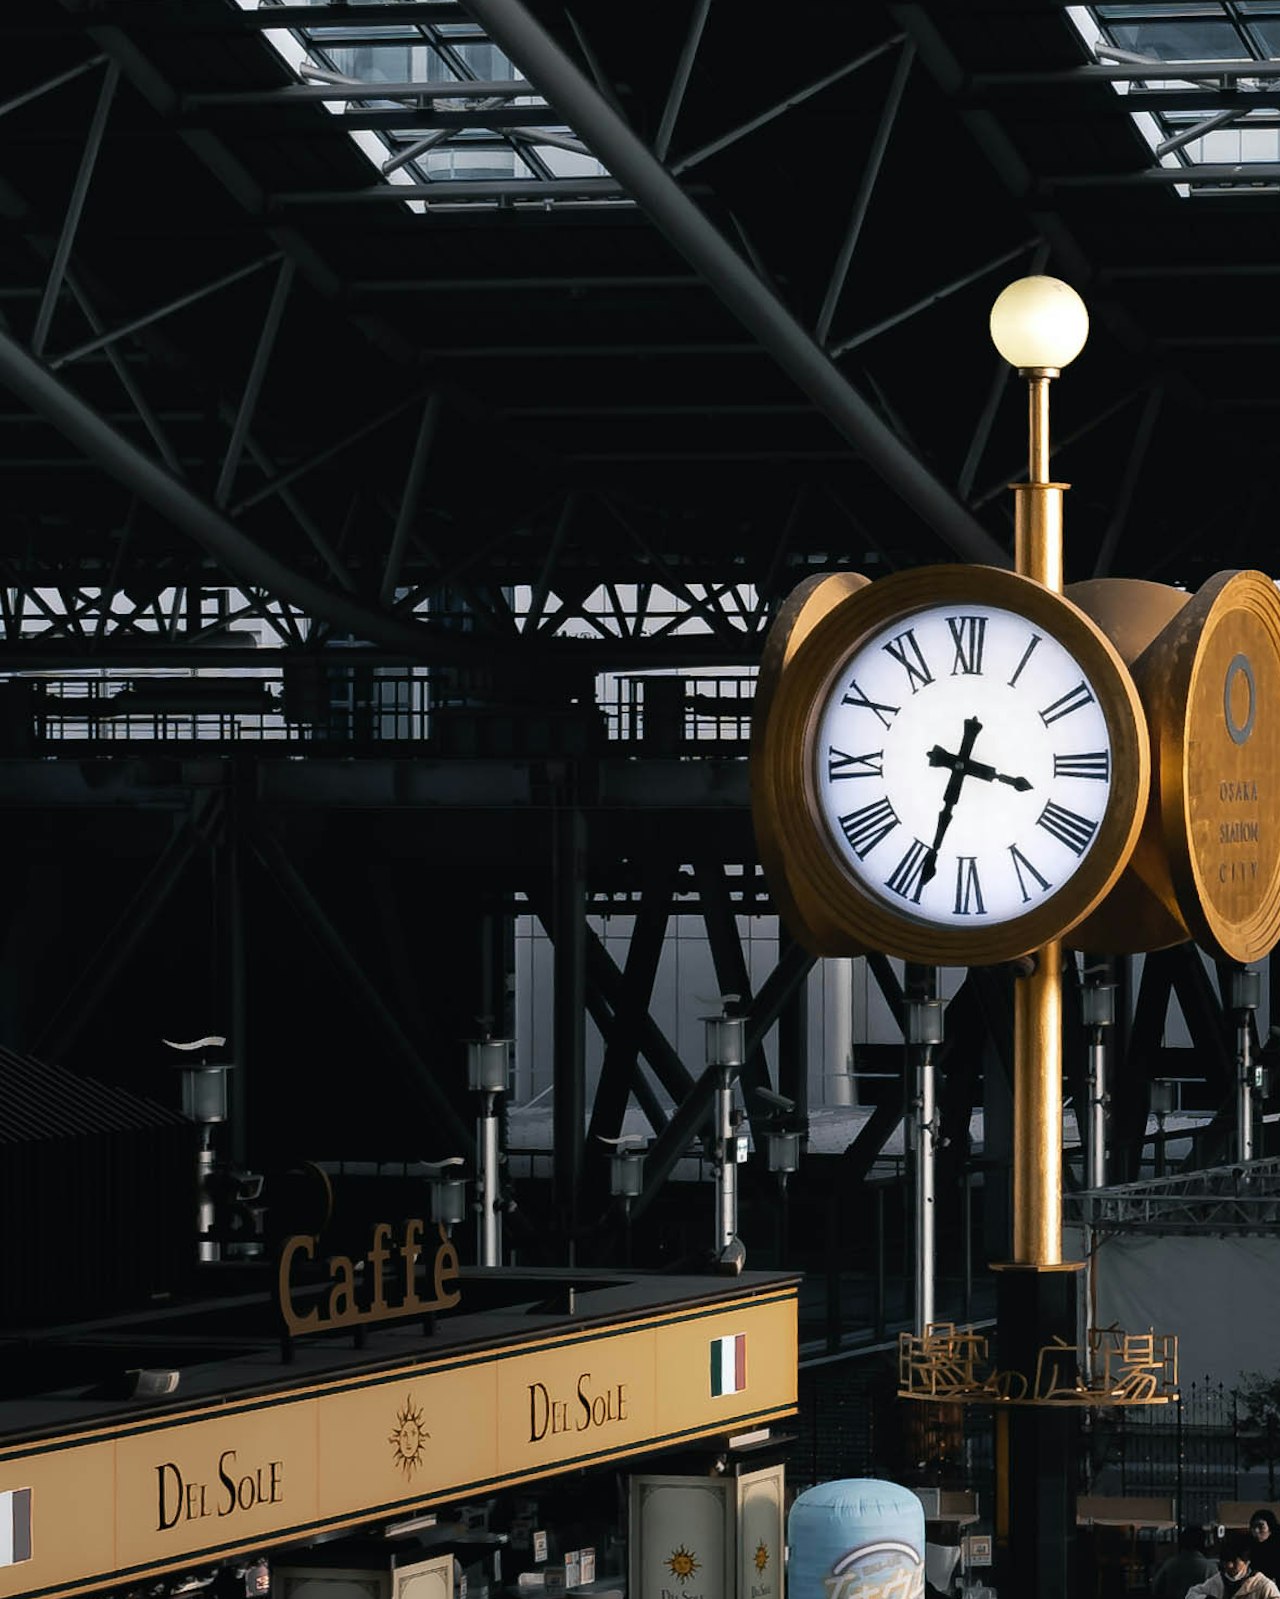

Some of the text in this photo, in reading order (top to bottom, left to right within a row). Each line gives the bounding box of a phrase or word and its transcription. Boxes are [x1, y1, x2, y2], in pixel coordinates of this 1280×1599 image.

[1219, 781, 1258, 802] OSAKA
[1219, 822, 1258, 844] STATION
[1219, 861, 1258, 884] CITY
[278, 1218, 463, 1330] Caffè
[528, 1372, 628, 1444] DEL SOLE
[155, 1450, 285, 1532] DEL SOLE
